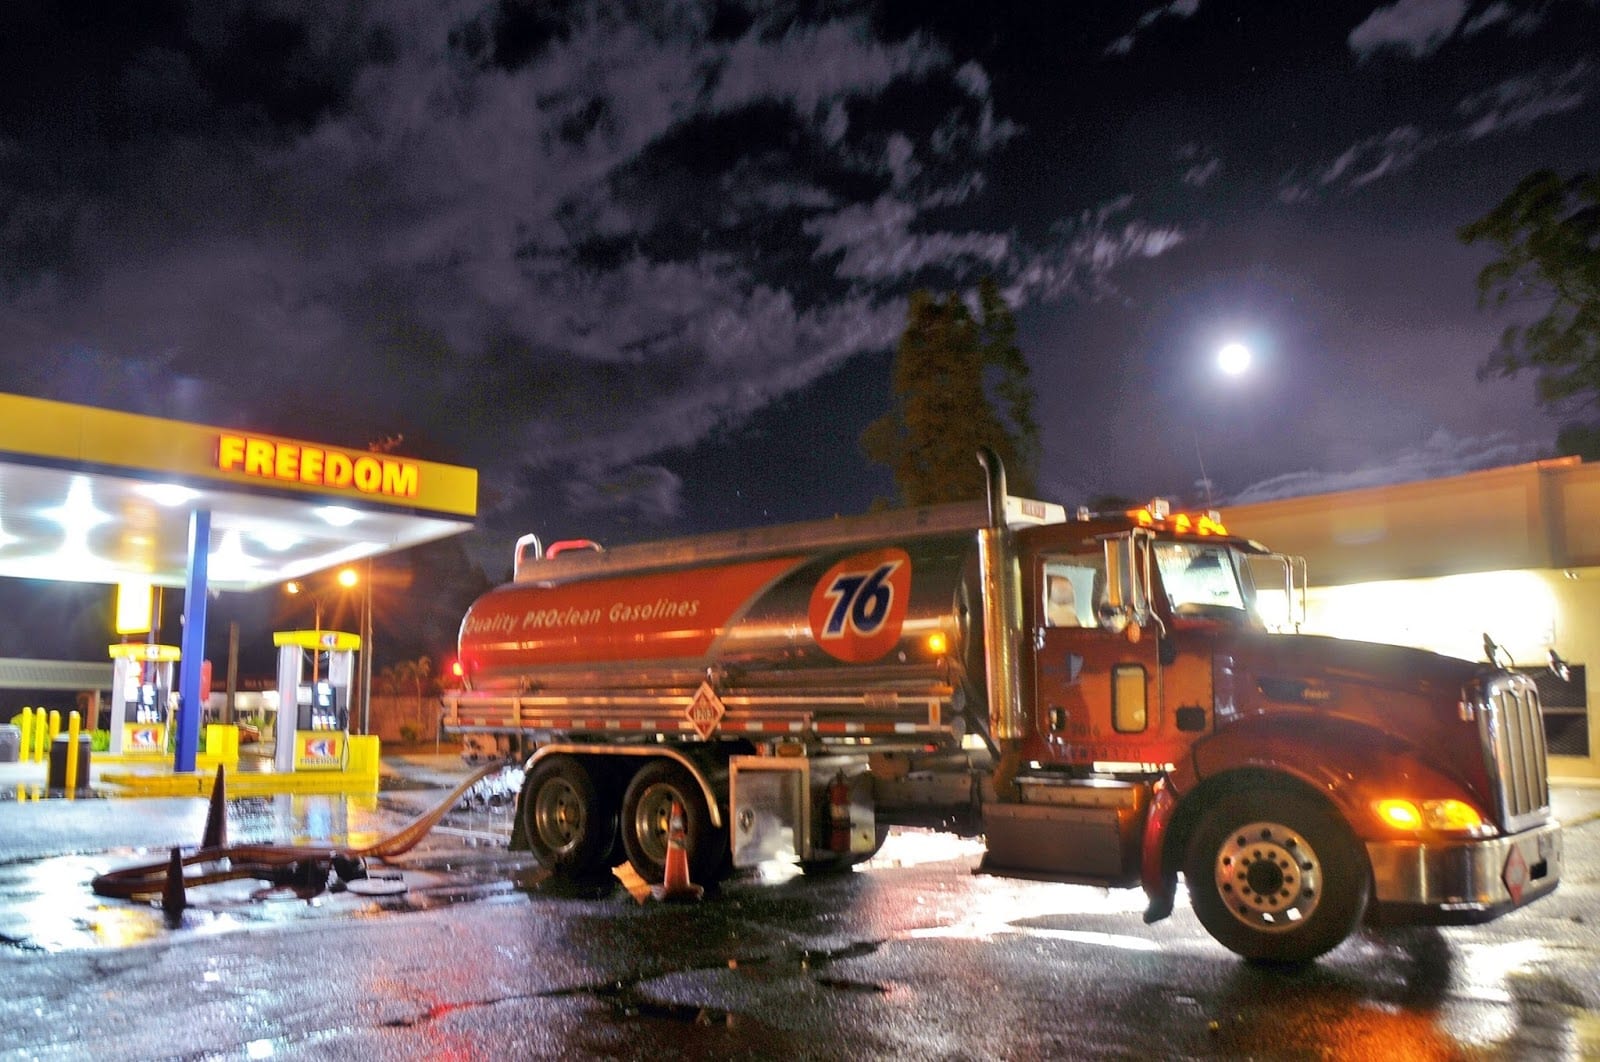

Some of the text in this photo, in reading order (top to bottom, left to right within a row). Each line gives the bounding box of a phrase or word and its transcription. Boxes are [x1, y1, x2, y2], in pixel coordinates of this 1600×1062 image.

[219, 434, 419, 498] FREEDOM
[464, 598, 700, 634] Quality PROclean Gasolines
[821, 560, 903, 640] 76
